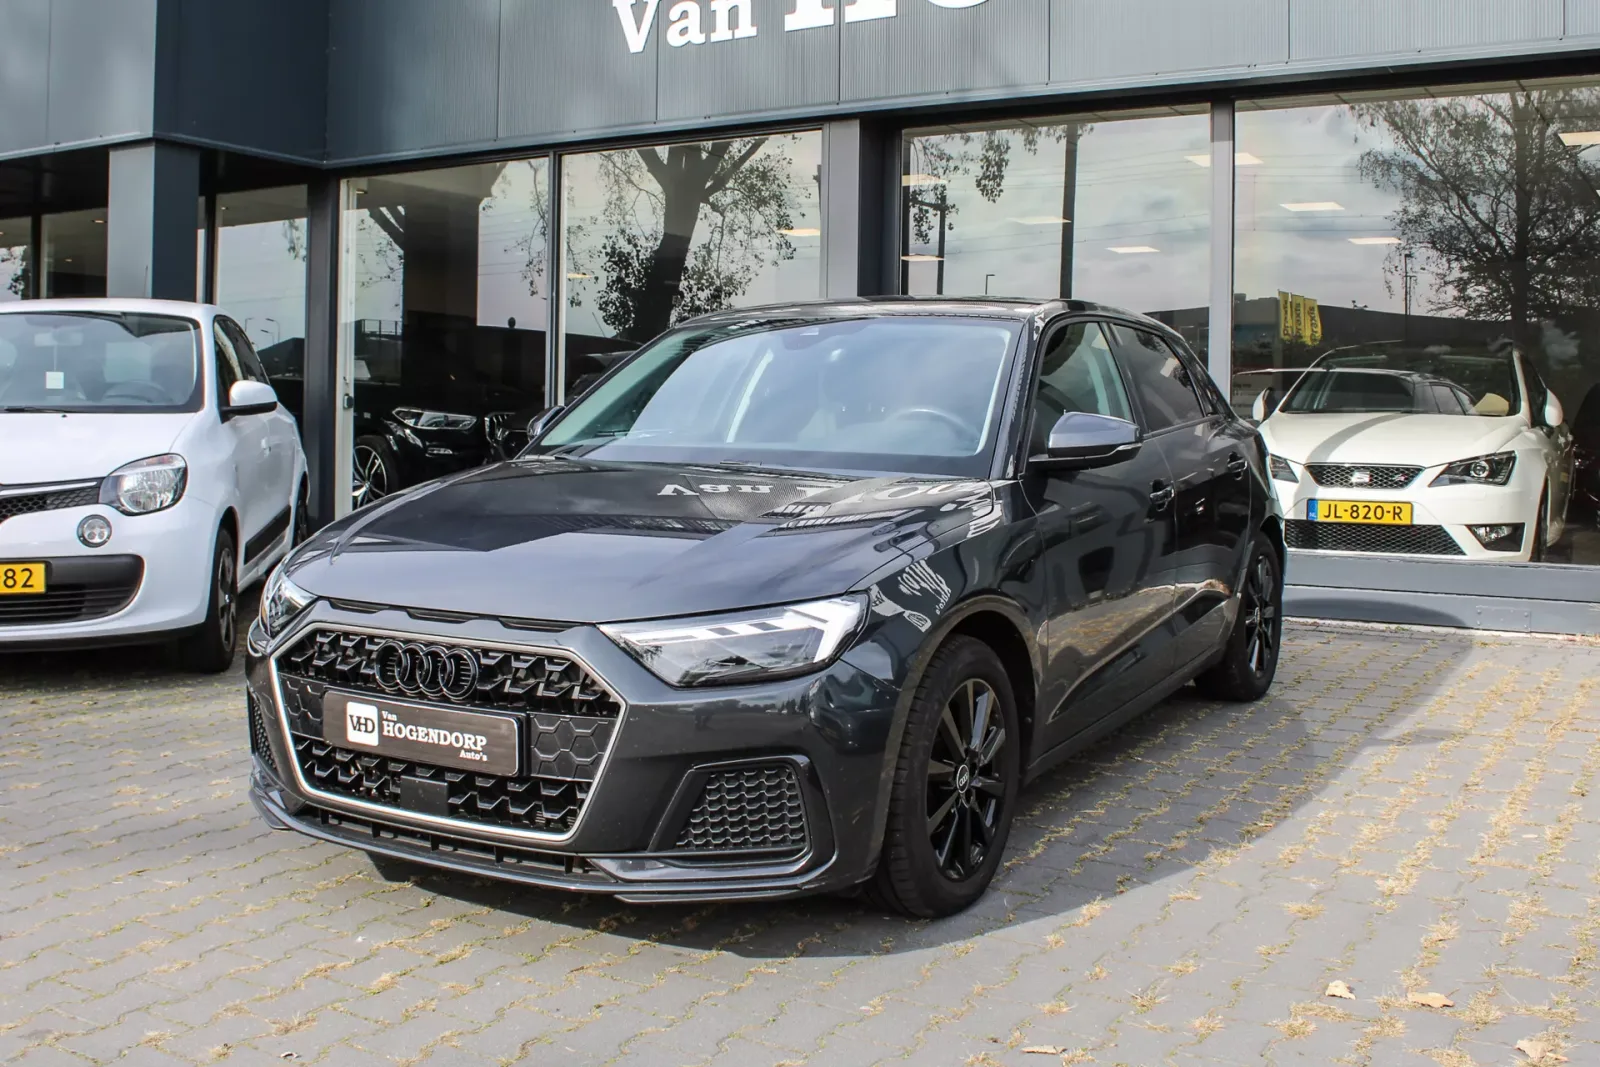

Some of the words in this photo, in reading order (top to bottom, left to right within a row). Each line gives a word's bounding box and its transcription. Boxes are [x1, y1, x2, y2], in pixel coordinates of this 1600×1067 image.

[611, 0, 758, 54] Van
[1323, 503, 1403, 521] JL-820-R
[381, 710, 398, 721] Van
[382, 720, 488, 751] HOGENDORP
[459, 749, 488, 762] Auto's
